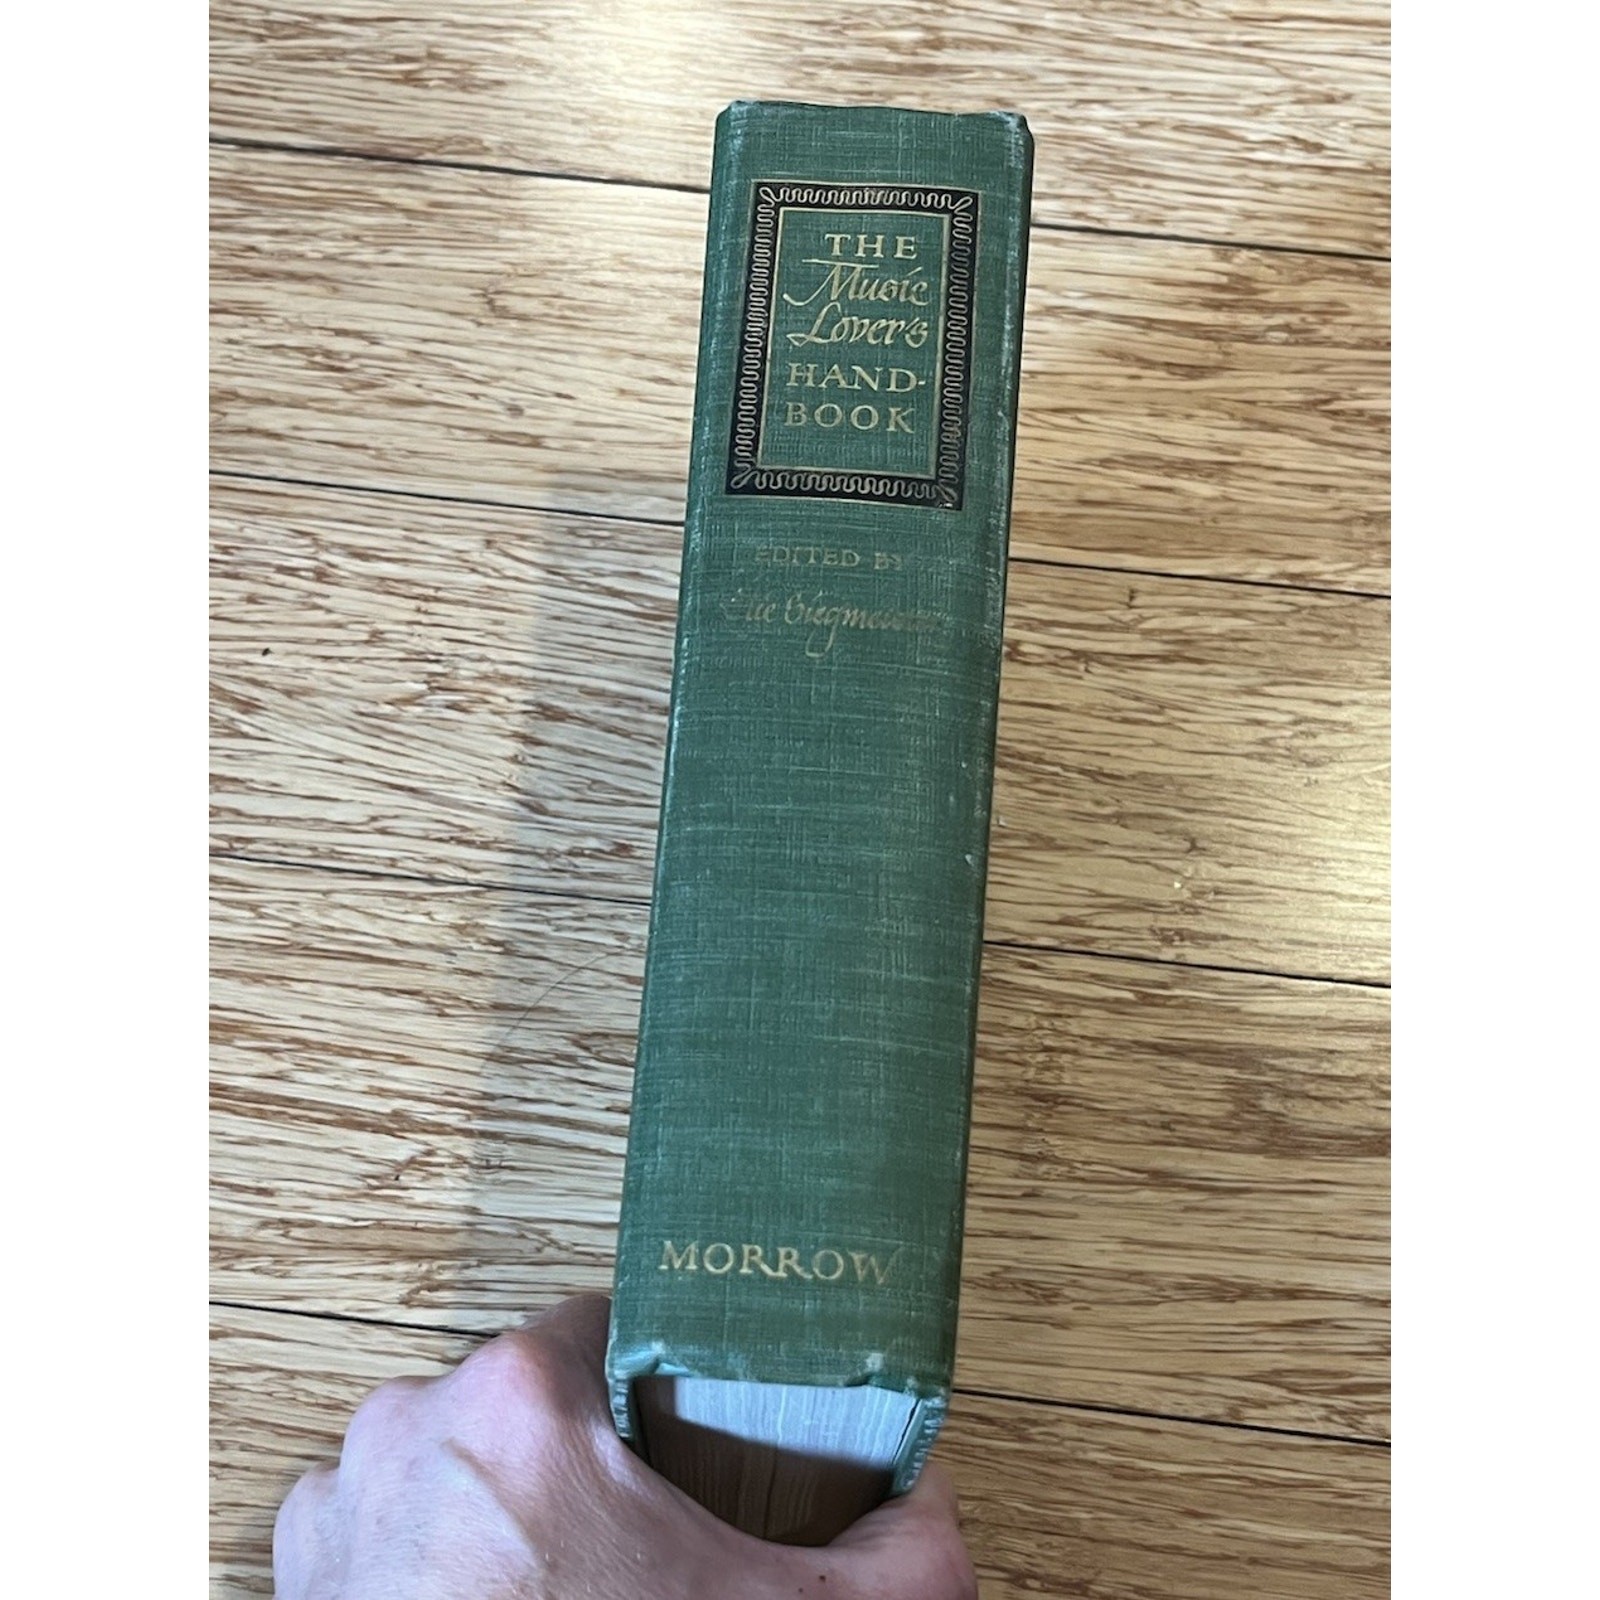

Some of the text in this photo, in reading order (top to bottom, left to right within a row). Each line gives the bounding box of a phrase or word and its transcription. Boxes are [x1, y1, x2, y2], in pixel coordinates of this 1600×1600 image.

[824, 233, 918, 260] THE
[782, 258, 930, 306] Music
[786, 301, 928, 349] Lover's
[785, 362, 926, 393] HAND-
[783, 401, 916, 434] BOOK
[755, 545, 860, 568] EDITED
[658, 1240, 903, 1285] MORROW
